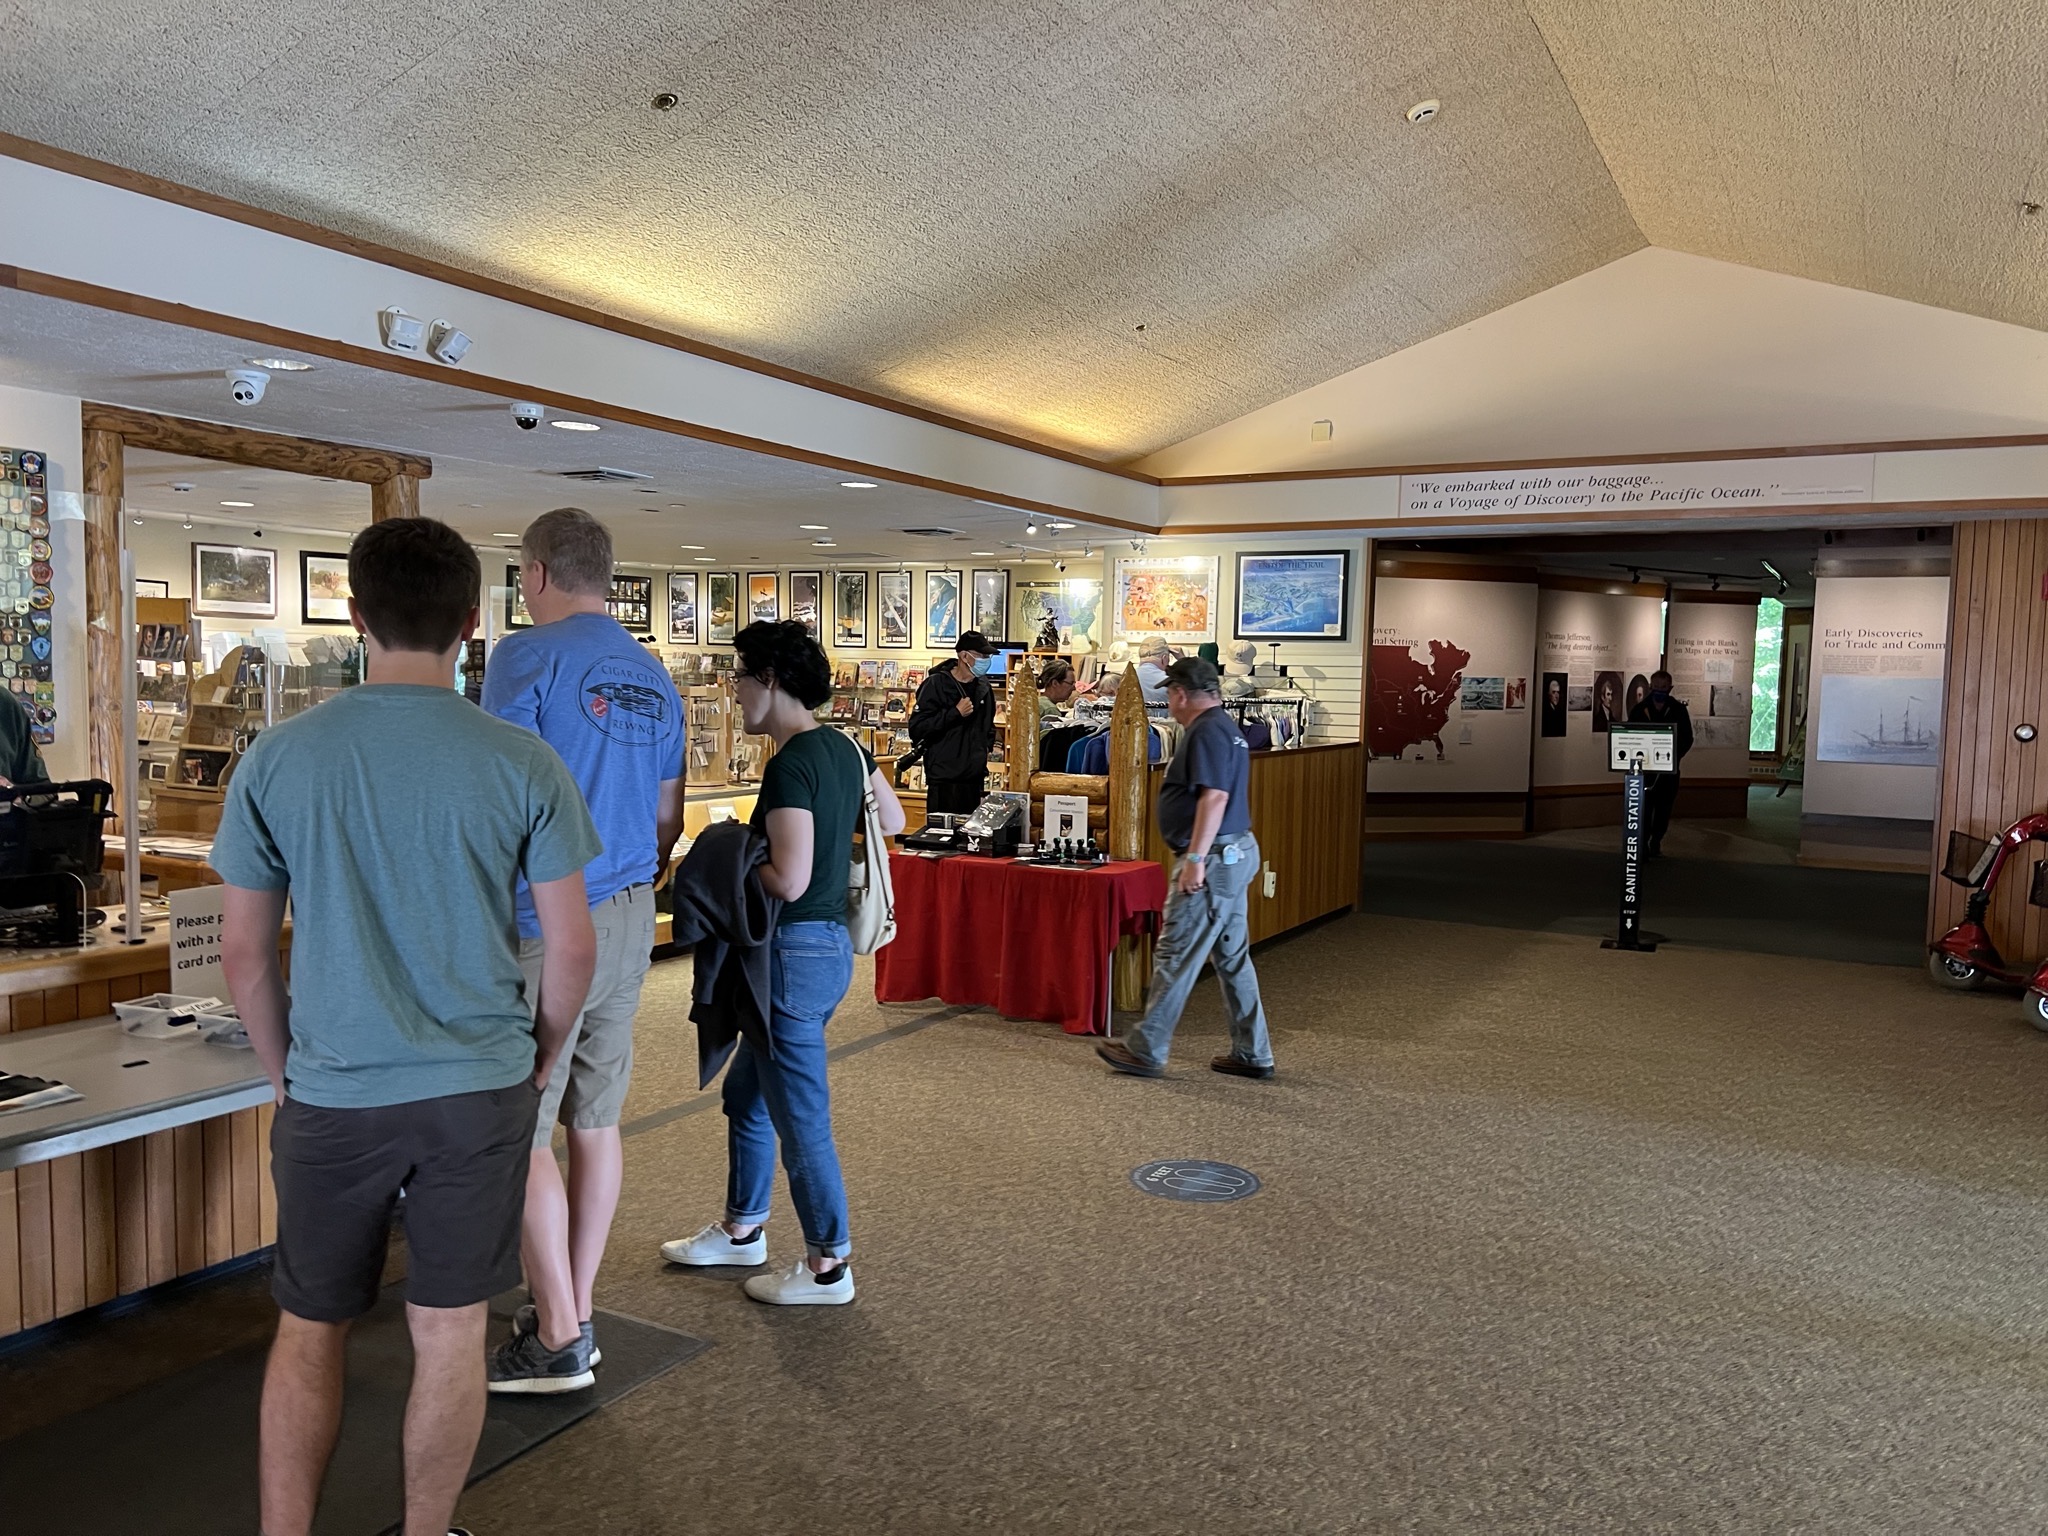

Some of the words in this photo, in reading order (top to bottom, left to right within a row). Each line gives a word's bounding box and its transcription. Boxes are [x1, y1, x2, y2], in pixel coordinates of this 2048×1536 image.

[1445, 479, 1516, 492] embarked
[1520, 477, 1552, 490] with
[1557, 478, 1584, 488] our
[1588, 475, 1664, 490] baggage...
[1410, 501, 1427, 510] on
[1433, 501, 1443, 510] a
[1450, 497, 1499, 511] Voyage
[1504, 494, 1521, 508] of
[1524, 493, 1596, 507] Discovery
[1601, 491, 1615, 503] to
[1621, 490, 1644, 502] the
[1650, 487, 1704, 503] Pacific
[1304, 561, 1325, 569] TRAIL
[1544, 631, 1566, 641] Thomas
[1825, 628, 1853, 639] Early
[1858, 628, 1924, 638] Discoveries
[1389, 637, 1419, 648] Setting
[1559, 642, 1572, 651] long
[1572, 643, 1592, 651] desired
[1674, 638, 1695, 646] Filling
[1718, 639, 1738, 647] Blanks
[1824, 639, 1841, 648] for
[1845, 640, 1878, 649] Trade
[1882, 640, 1903, 649] and
[1684, 647, 1701, 656] Maps
[1703, 647, 1710, 655] of
[1724, 648, 1740, 656] West
[601, 665, 633, 679] CIGAR
[1627, 779, 1640, 830] STATION
[1625, 836, 1637, 903] SANITIZER
[176, 915, 215, 929] Please
[176, 934, 204, 949] with
[207, 935, 214, 944] a
[177, 954, 203, 969] card
[1150, 1165, 1174, 1178] FEET
